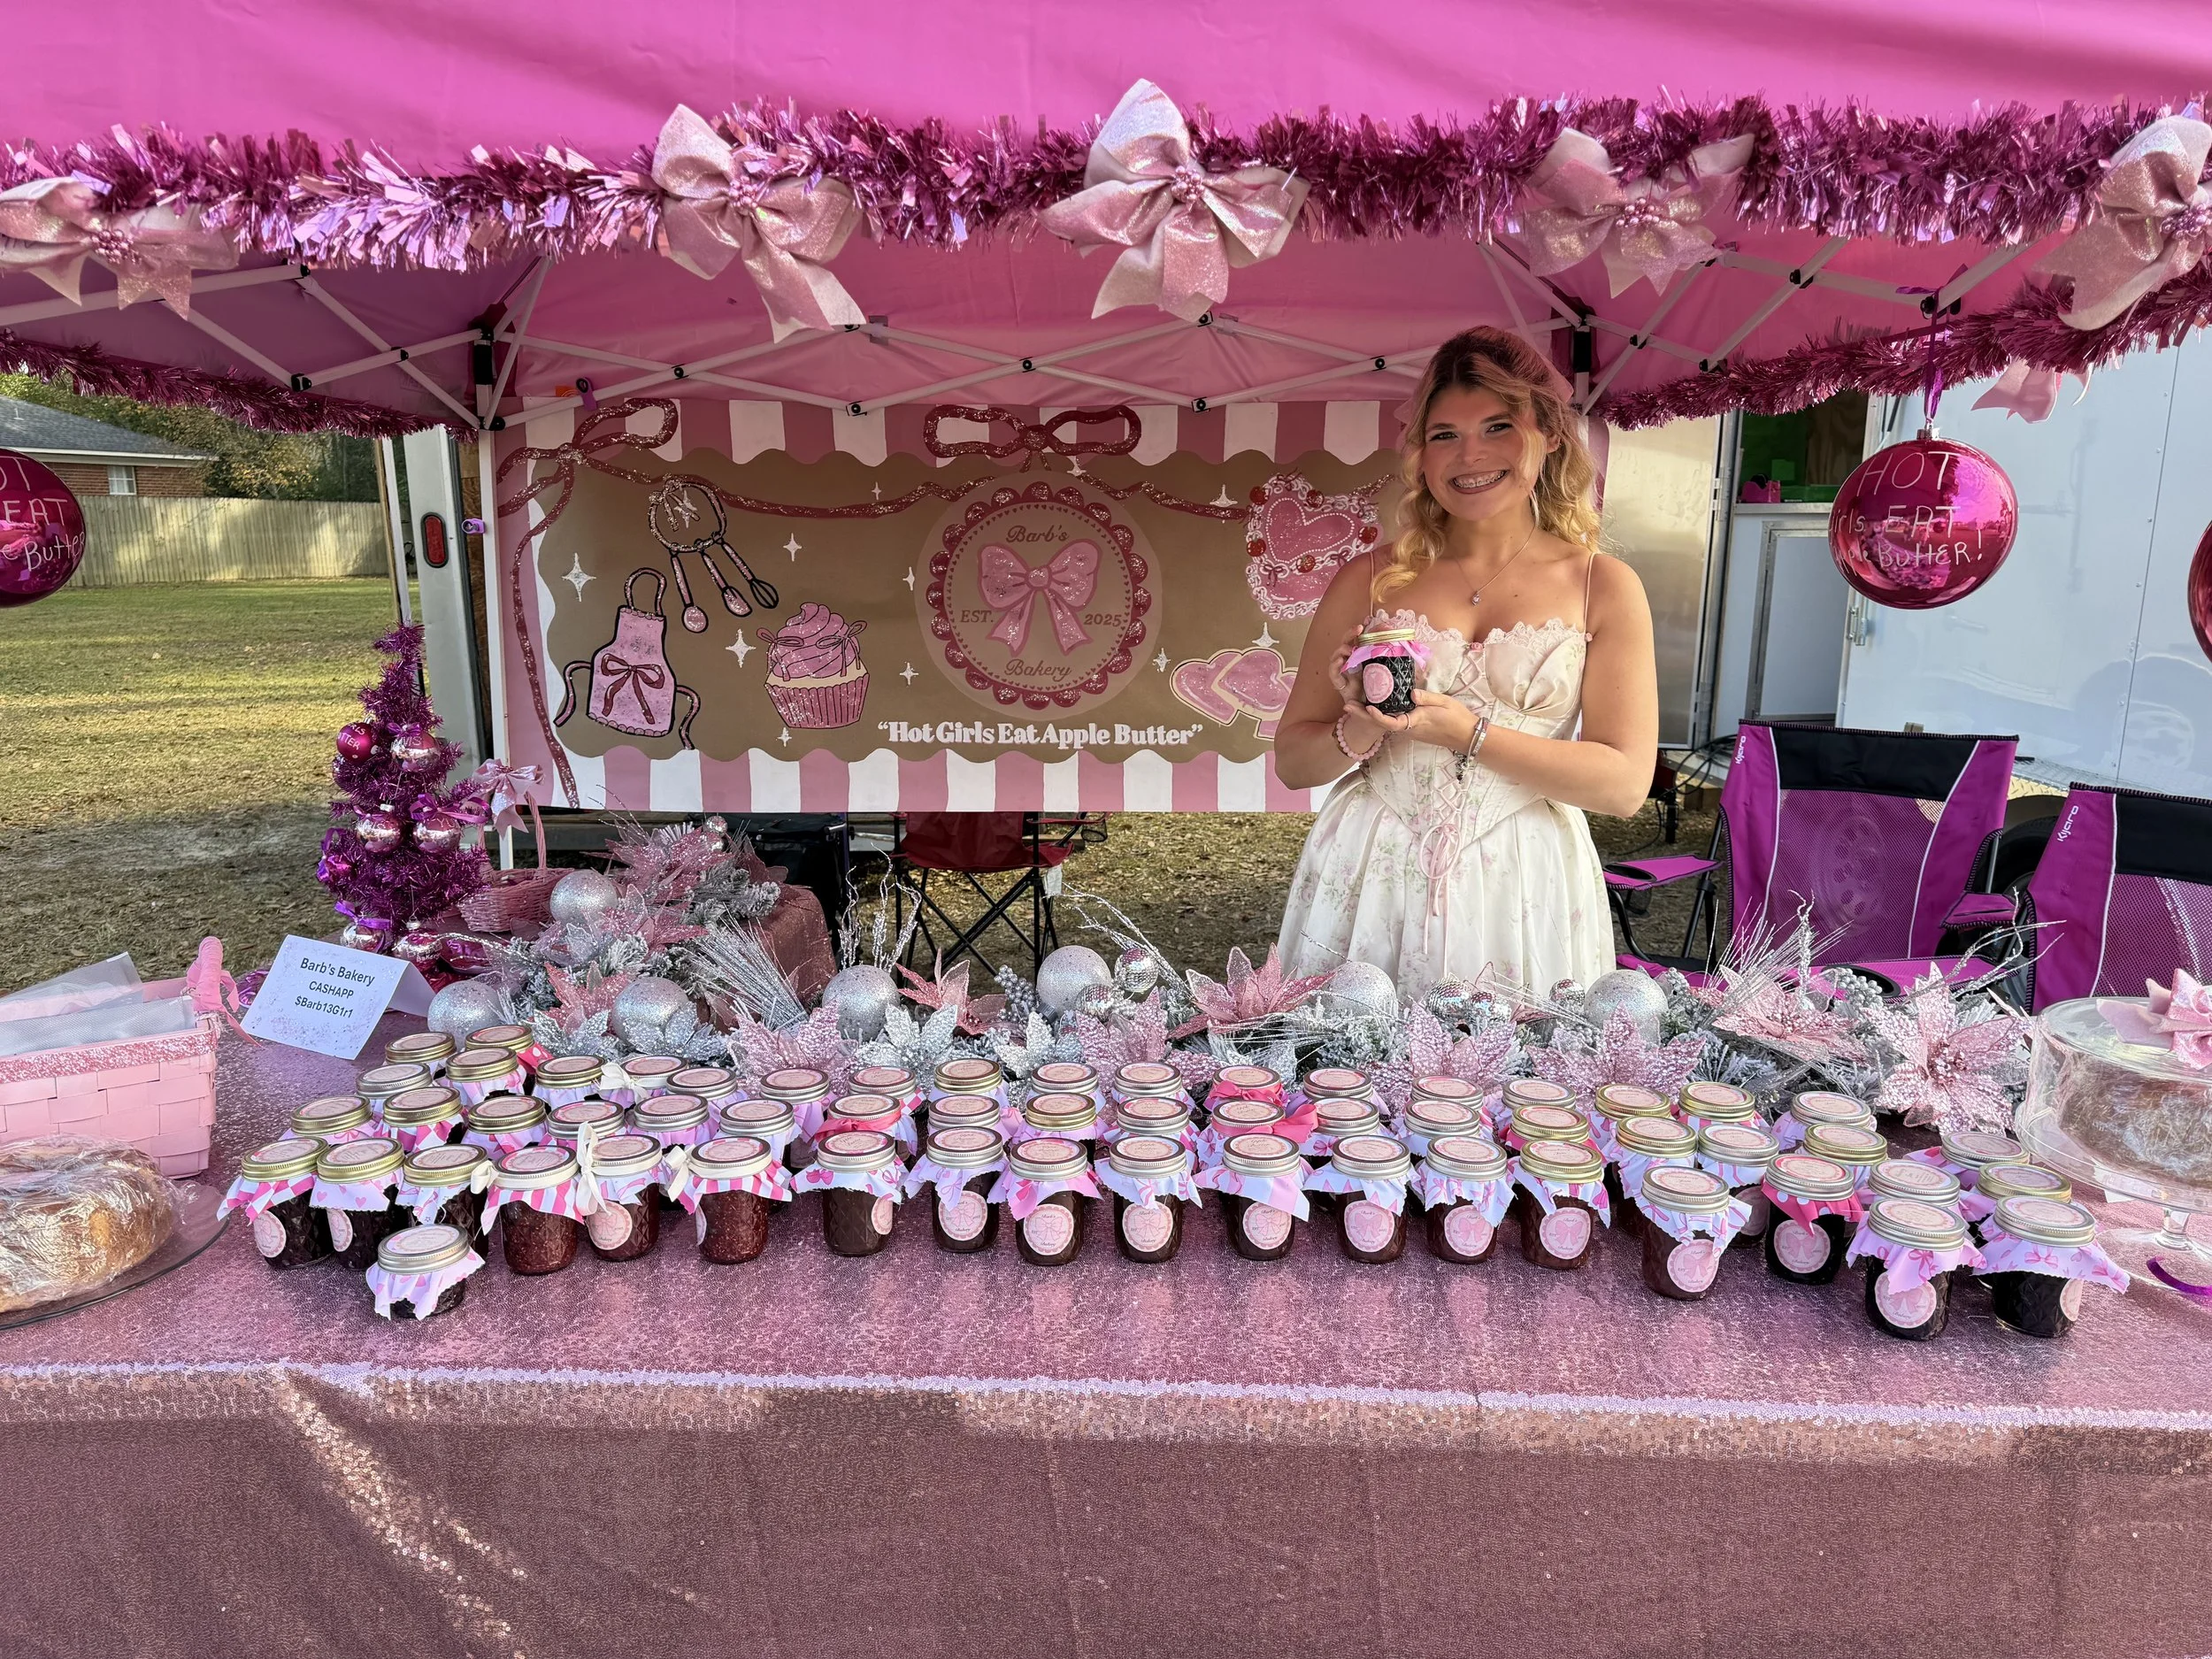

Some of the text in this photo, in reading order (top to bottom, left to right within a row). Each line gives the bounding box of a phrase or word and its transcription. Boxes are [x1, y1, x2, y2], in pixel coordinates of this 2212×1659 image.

[1856, 450, 1962, 497] HOT
[3, 497, 68, 526] EAT
[1885, 505, 1962, 539] EAT
[1005, 524, 1070, 543] Barb's
[960, 610, 1123, 627] EST. 2025
[1003, 658, 1072, 682] Bakery
[935, 722, 995, 744] Girls
[997, 723, 1041, 744] Eat
[1040, 723, 1110, 750] Apple
[2057, 805, 2079, 841] Kijaro
[300, 957, 376, 987] Barb's Bakery
[309, 980, 355, 1000] CASHAPP
